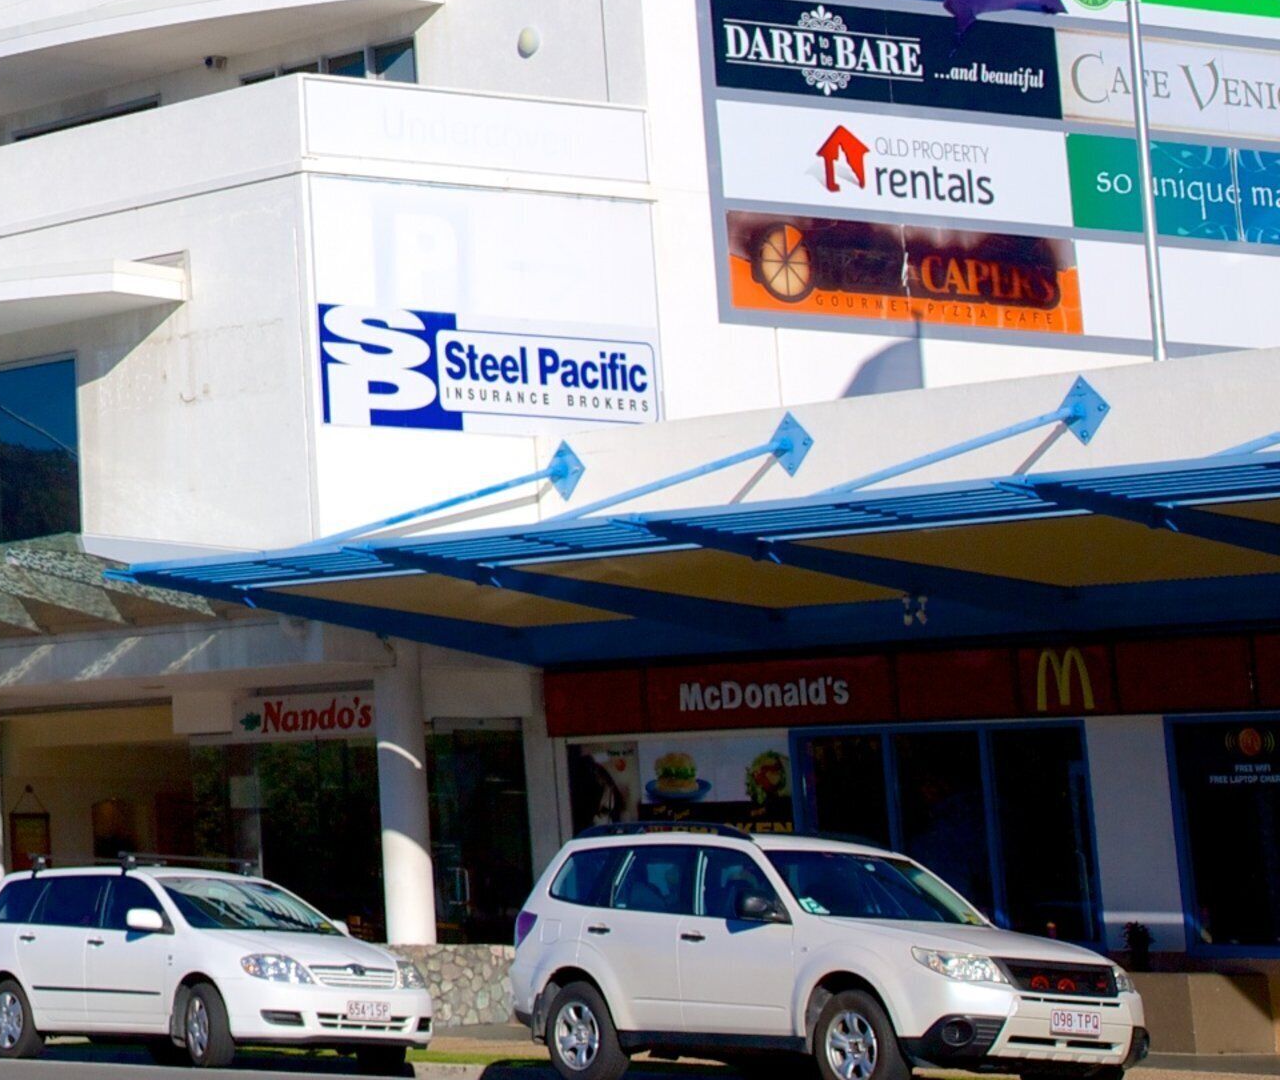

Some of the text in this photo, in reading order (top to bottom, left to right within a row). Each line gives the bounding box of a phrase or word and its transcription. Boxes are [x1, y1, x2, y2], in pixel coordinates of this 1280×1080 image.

[723, 23, 924, 77] DARE to be BARE
[980, 67, 1045, 94] beautiful
[1071, 51, 1280, 112] CAE VENI
[875, 137, 989, 164] QLD PROPERTY
[875, 165, 995, 205] rentals
[1096, 171, 1133, 194] so
[815, 294, 1054, 325] GOURMET PIZZA CAFE
[444, 339, 648, 394] Steel Pacific
[445, 385, 649, 412] INSURANCE BROKERS
[679, 675, 850, 712] McDonald's
[261, 696, 373, 734] Nando's
[1052, 1011, 1099, 1030] 098 TPQ
